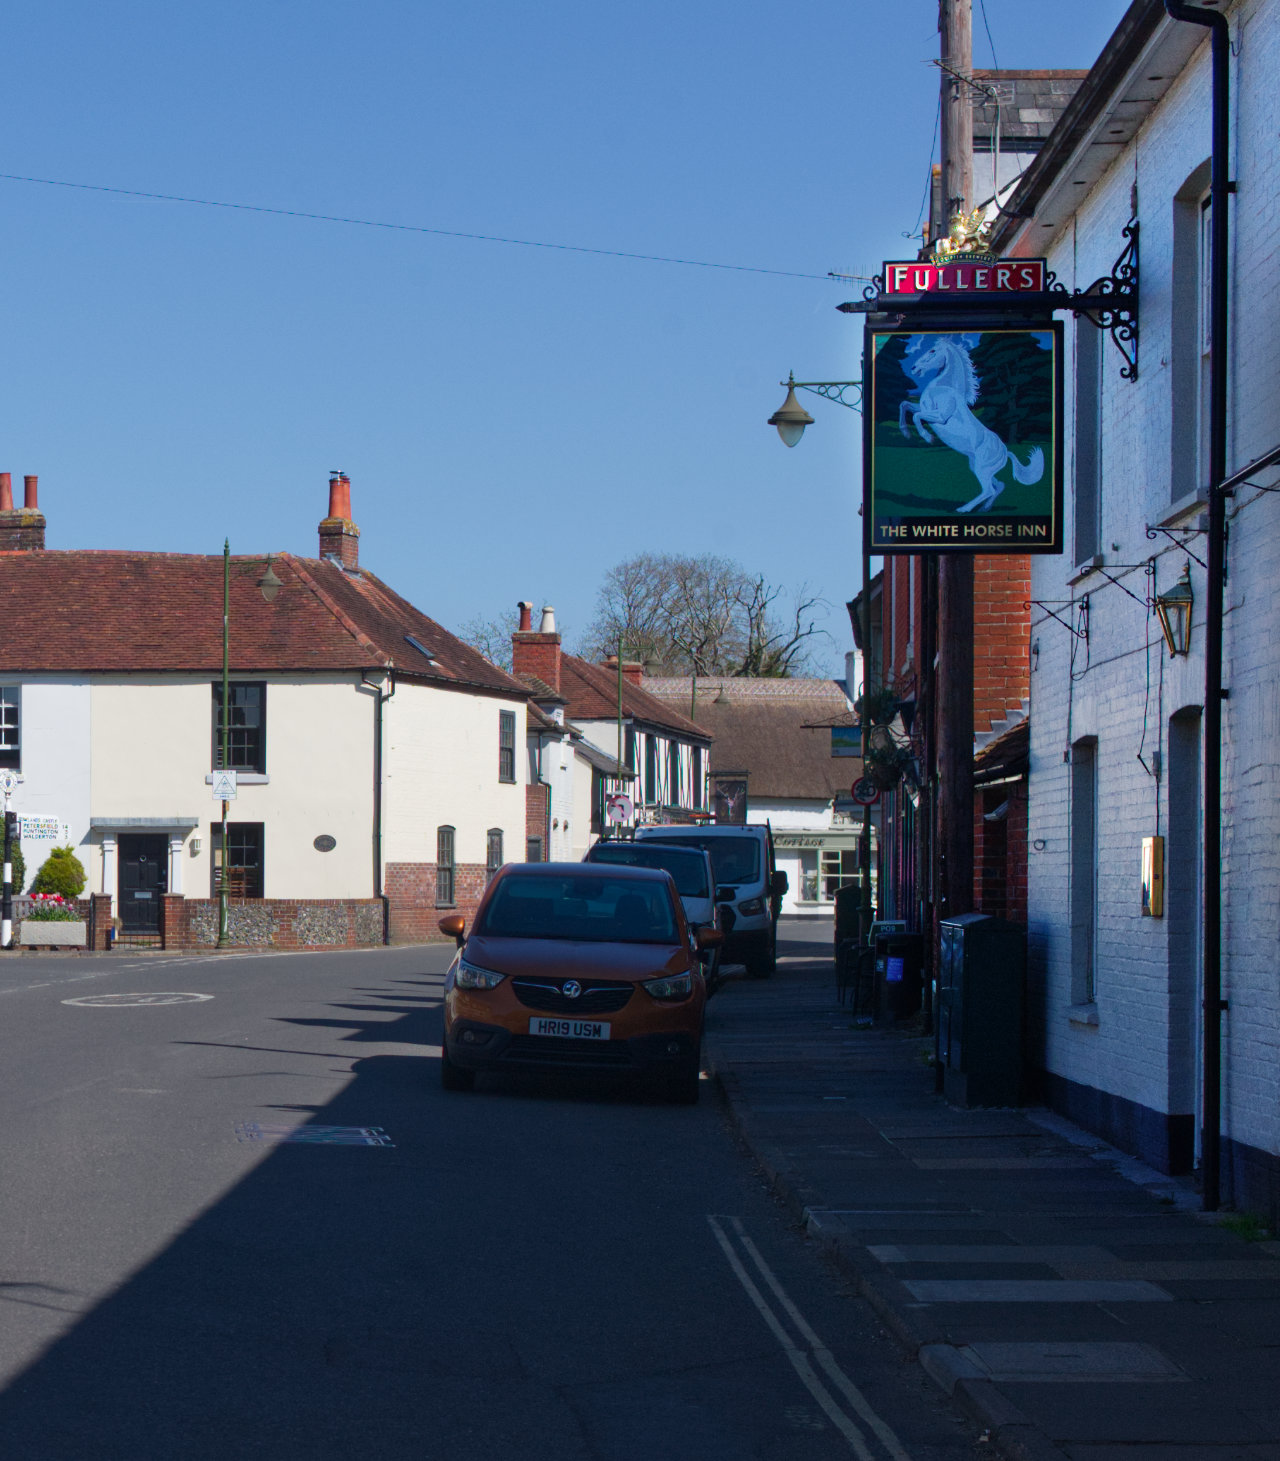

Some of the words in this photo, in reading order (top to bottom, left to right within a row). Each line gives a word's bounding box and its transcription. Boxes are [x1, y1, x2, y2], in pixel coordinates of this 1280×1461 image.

[894, 265, 1033, 291] FULLER'S
[880, 525, 908, 537] THE
[912, 525, 959, 537] WHITE
[964, 525, 1014, 537] HORSE
[1018, 525, 1047, 537] INN
[539, 1020, 570, 1035] HR19
[573, 1022, 602, 1038] USM
